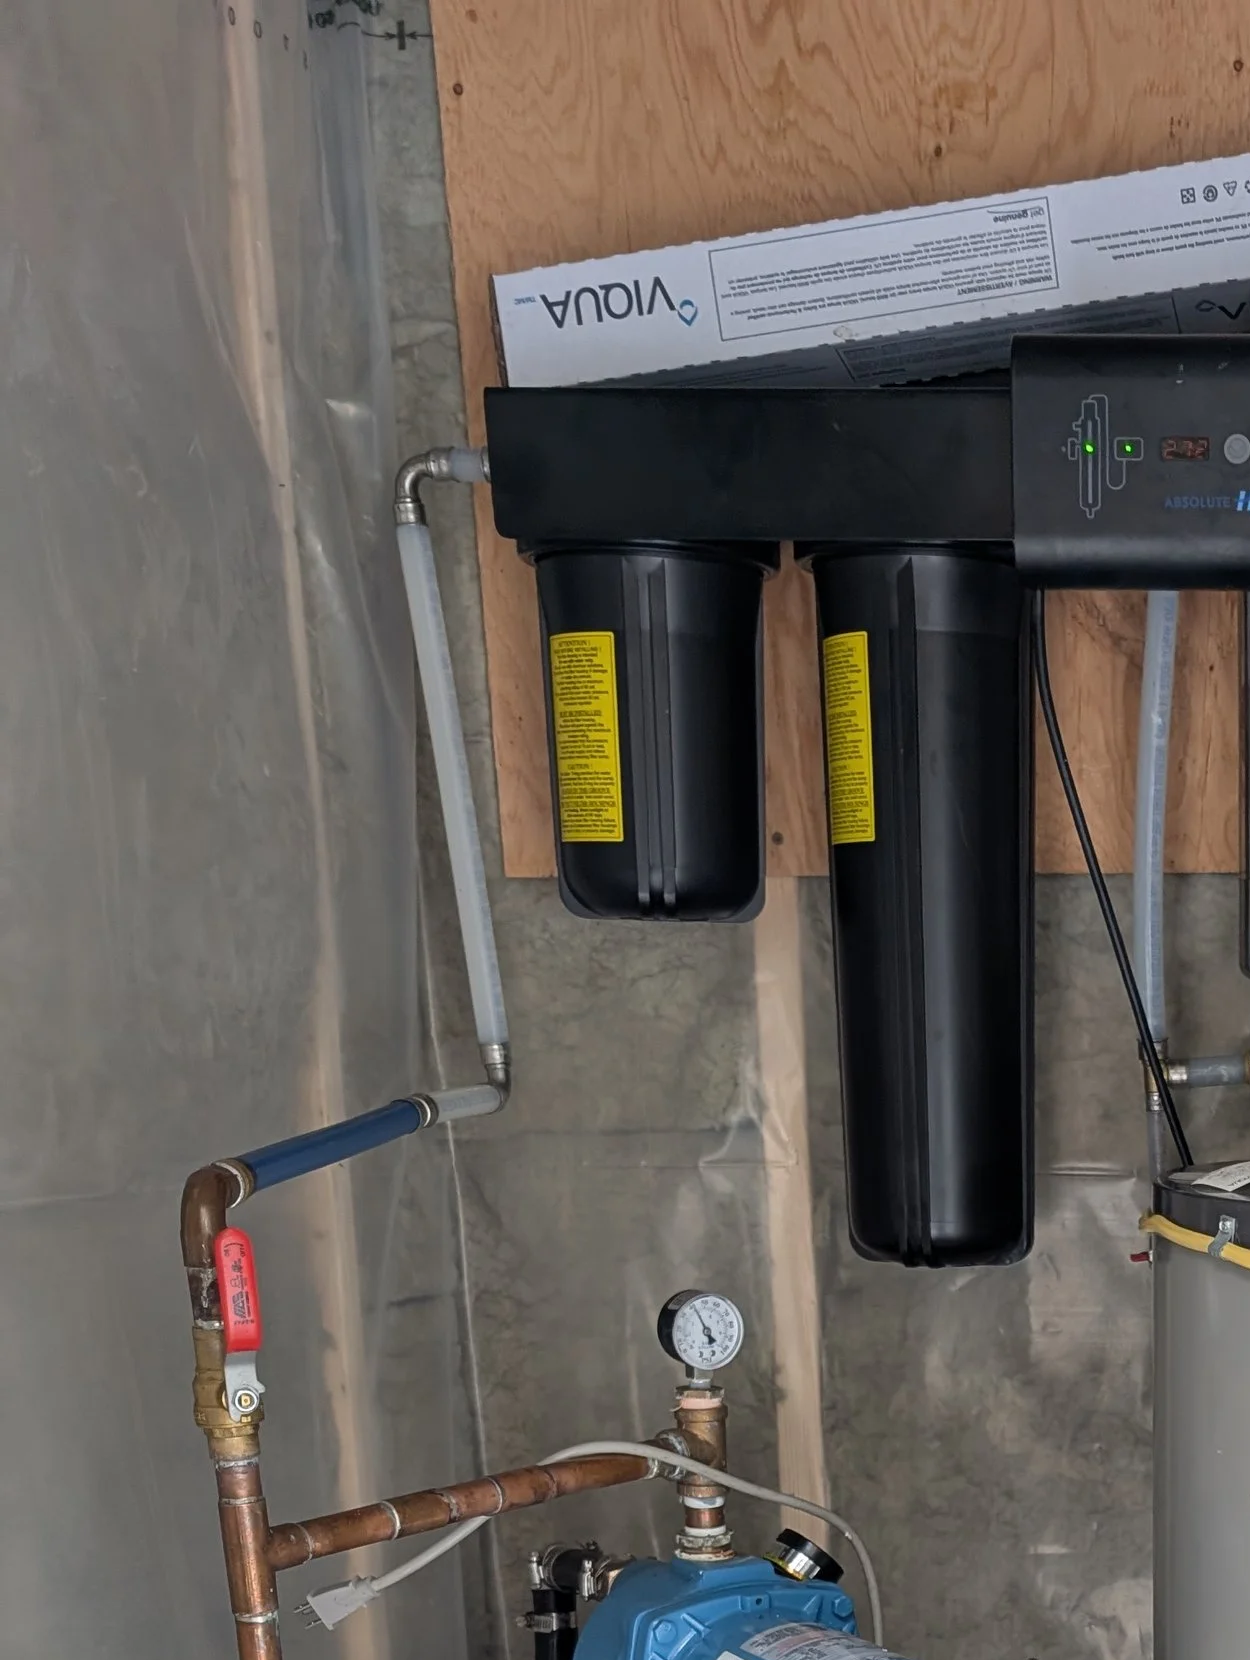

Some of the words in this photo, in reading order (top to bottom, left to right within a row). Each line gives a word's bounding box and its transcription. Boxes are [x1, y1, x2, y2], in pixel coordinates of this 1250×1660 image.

[993, 210, 1028, 223] genuine
[1019, 275, 1053, 286] WARNING
[957, 281, 1013, 296] AVERTISSEMENT
[540, 276, 677, 328] VIQUA
[1165, 496, 1231, 509] ABSOLUTE
